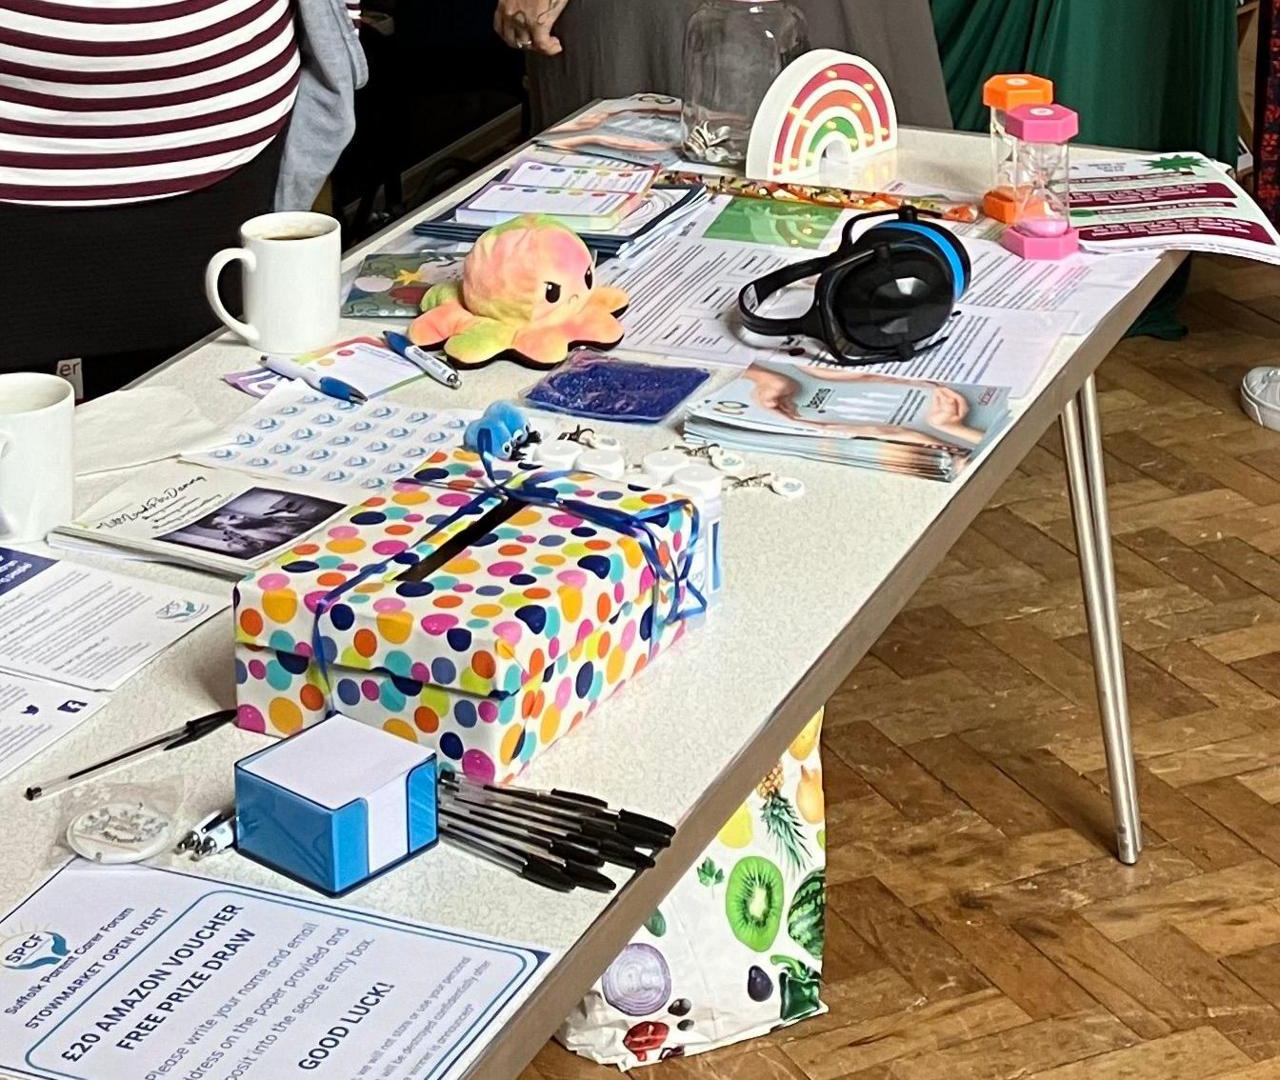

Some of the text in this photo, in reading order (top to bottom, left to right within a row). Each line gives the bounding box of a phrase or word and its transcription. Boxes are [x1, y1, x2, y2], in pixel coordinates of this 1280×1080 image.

[4, 908, 134, 1014] Suffolk Parent Carer Forum
[5, 934, 42, 963] SPCF
[25, 908, 167, 1028] STOWMARKET OPEN EVENT
[62, 905, 243, 1062] £20 AMAZON VOUCHER
[116, 929, 255, 1049] FREE PRIZE DRAW
[185, 1020, 218, 1044] write
[213, 996, 240, 1018] your
[238, 969, 271, 995] name
[267, 949, 291, 967] and
[287, 923, 318, 948] email
[220, 928, 349, 1049] on the paper provided and
[252, 939, 375, 1054] into the secure entry box.
[298, 982, 394, 1069] GOOD LUCK!
